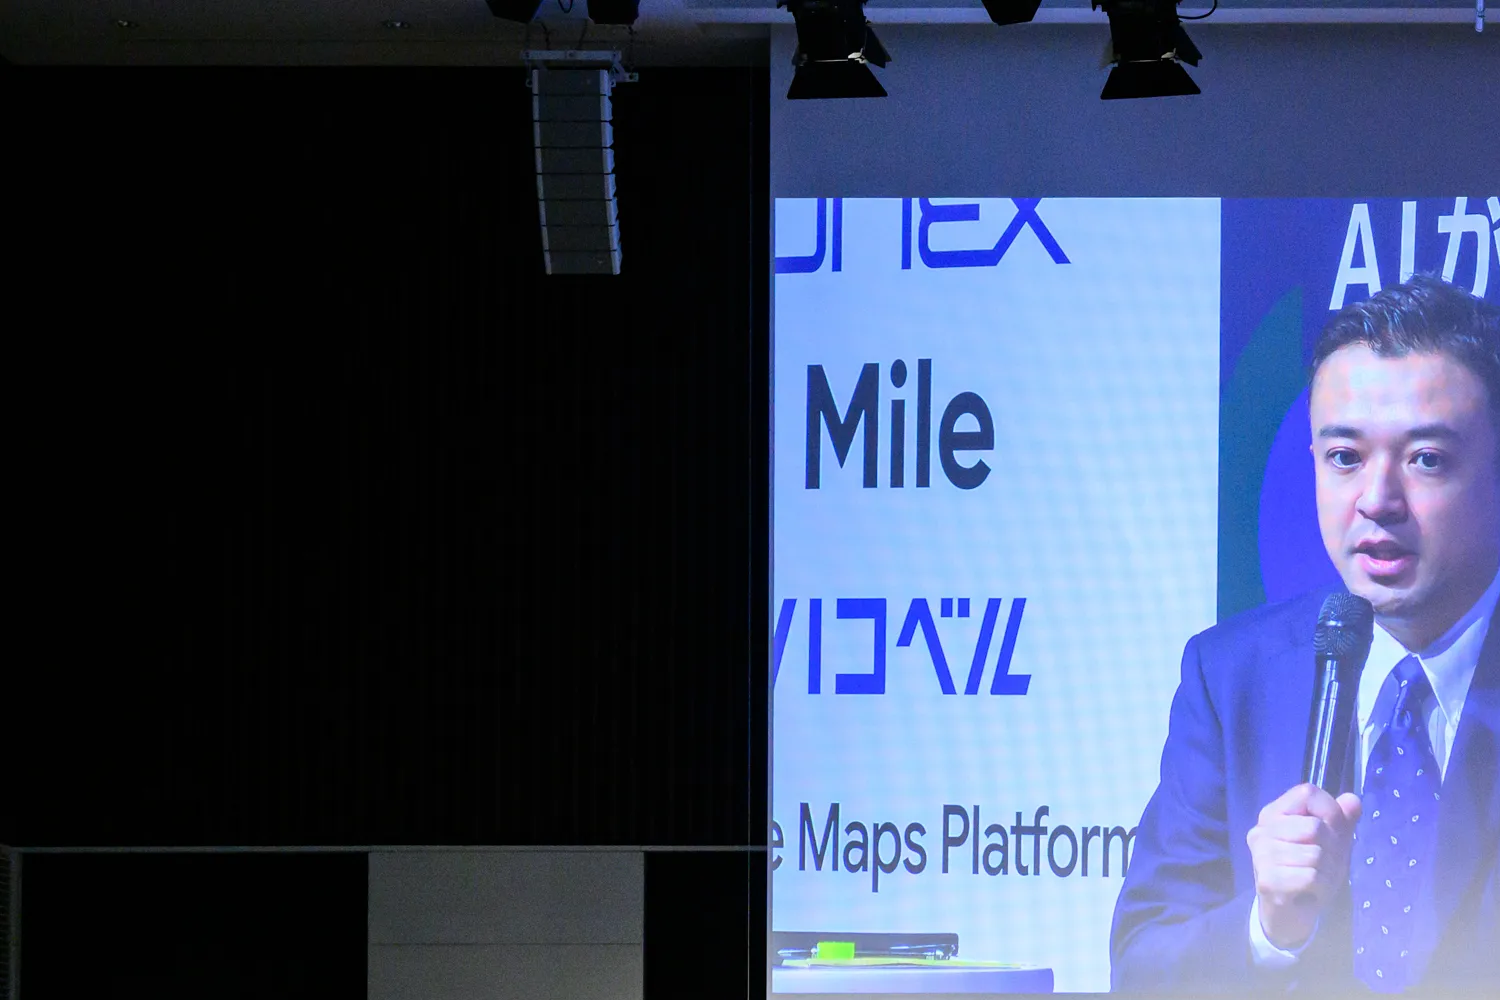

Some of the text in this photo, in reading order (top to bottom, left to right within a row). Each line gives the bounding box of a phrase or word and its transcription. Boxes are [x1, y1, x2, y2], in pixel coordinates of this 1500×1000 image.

[805, 358, 995, 490] Mile
[798, 802, 927, 893] Maps
[941, 804, 1138, 878] Platform
